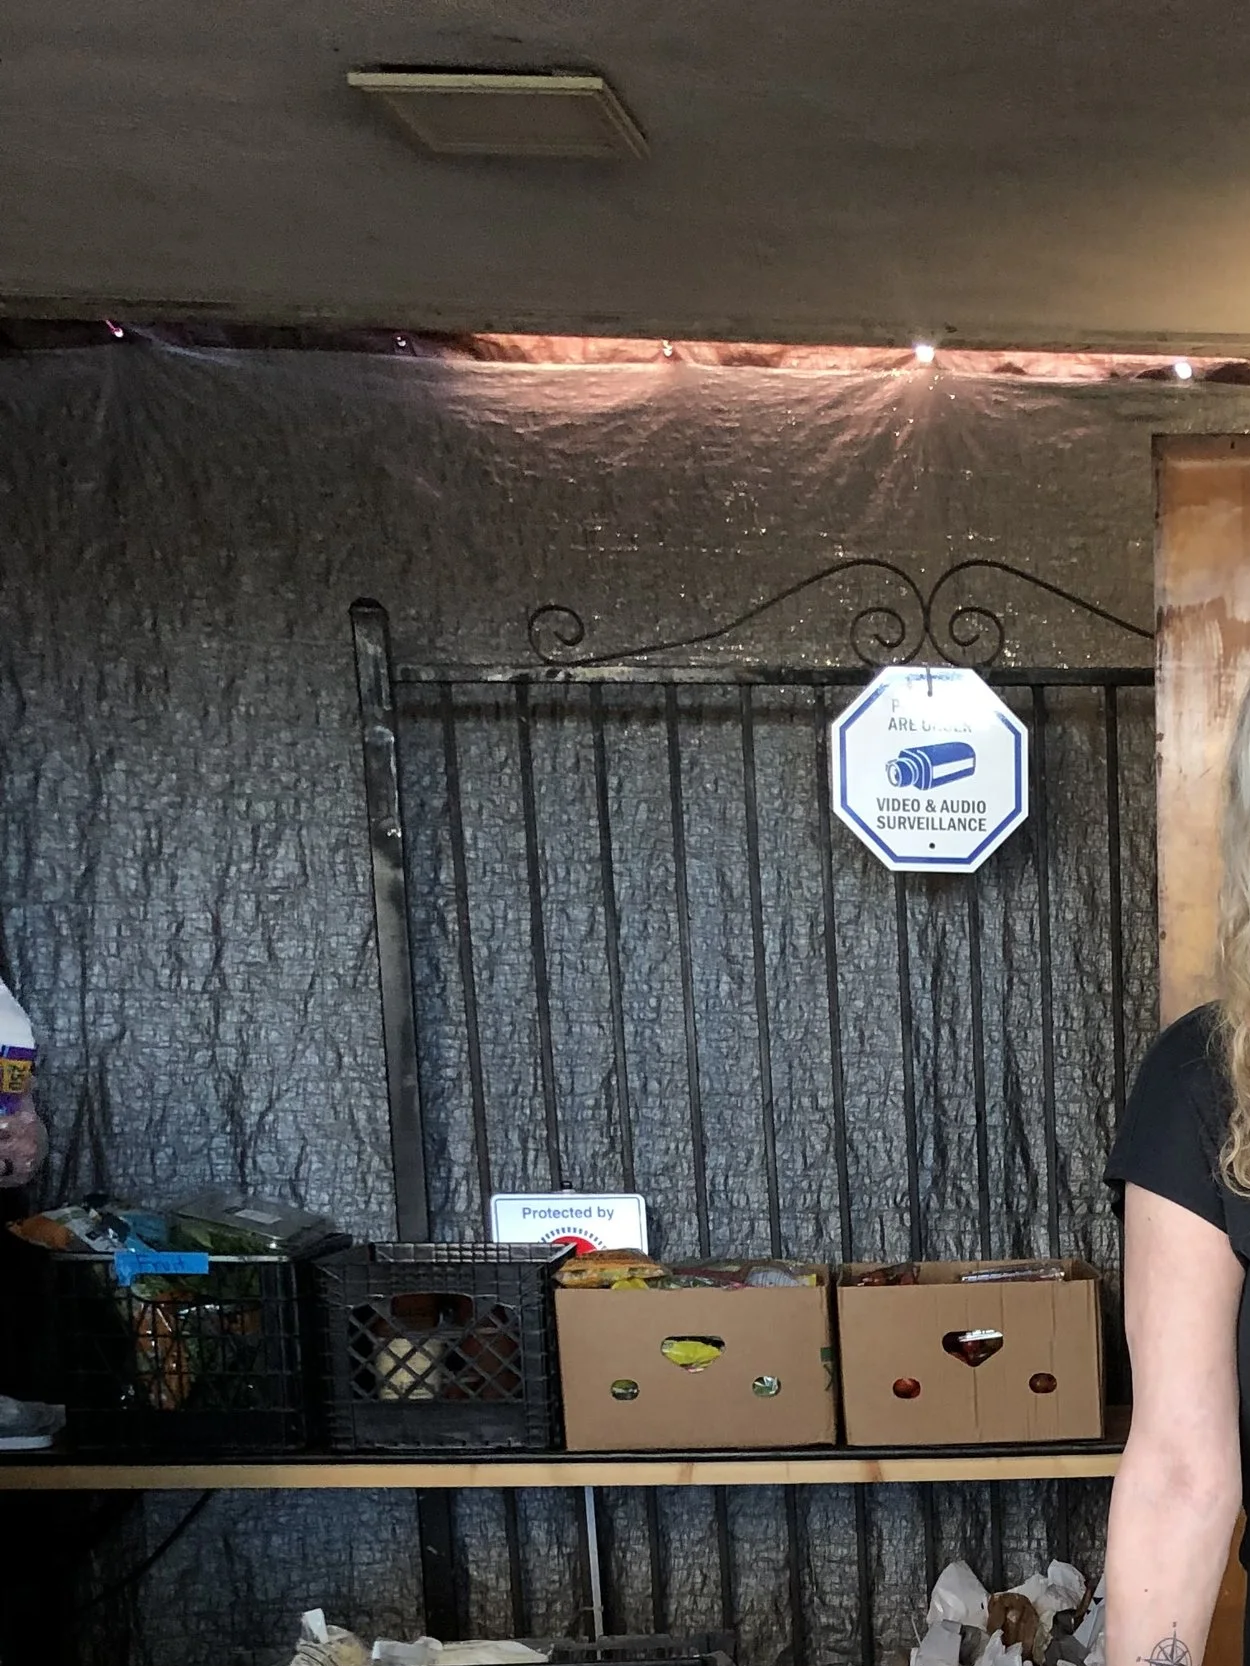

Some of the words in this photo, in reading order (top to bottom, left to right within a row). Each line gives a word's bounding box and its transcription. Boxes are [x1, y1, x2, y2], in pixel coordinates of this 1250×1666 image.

[876, 797, 921, 813] VIDEO
[925, 799, 936, 813] &
[940, 799, 987, 814] AUDIO
[876, 815, 987, 832] SURVEILLANCE
[522, 1207, 592, 1220] Protected
[597, 1206, 614, 1221] by
